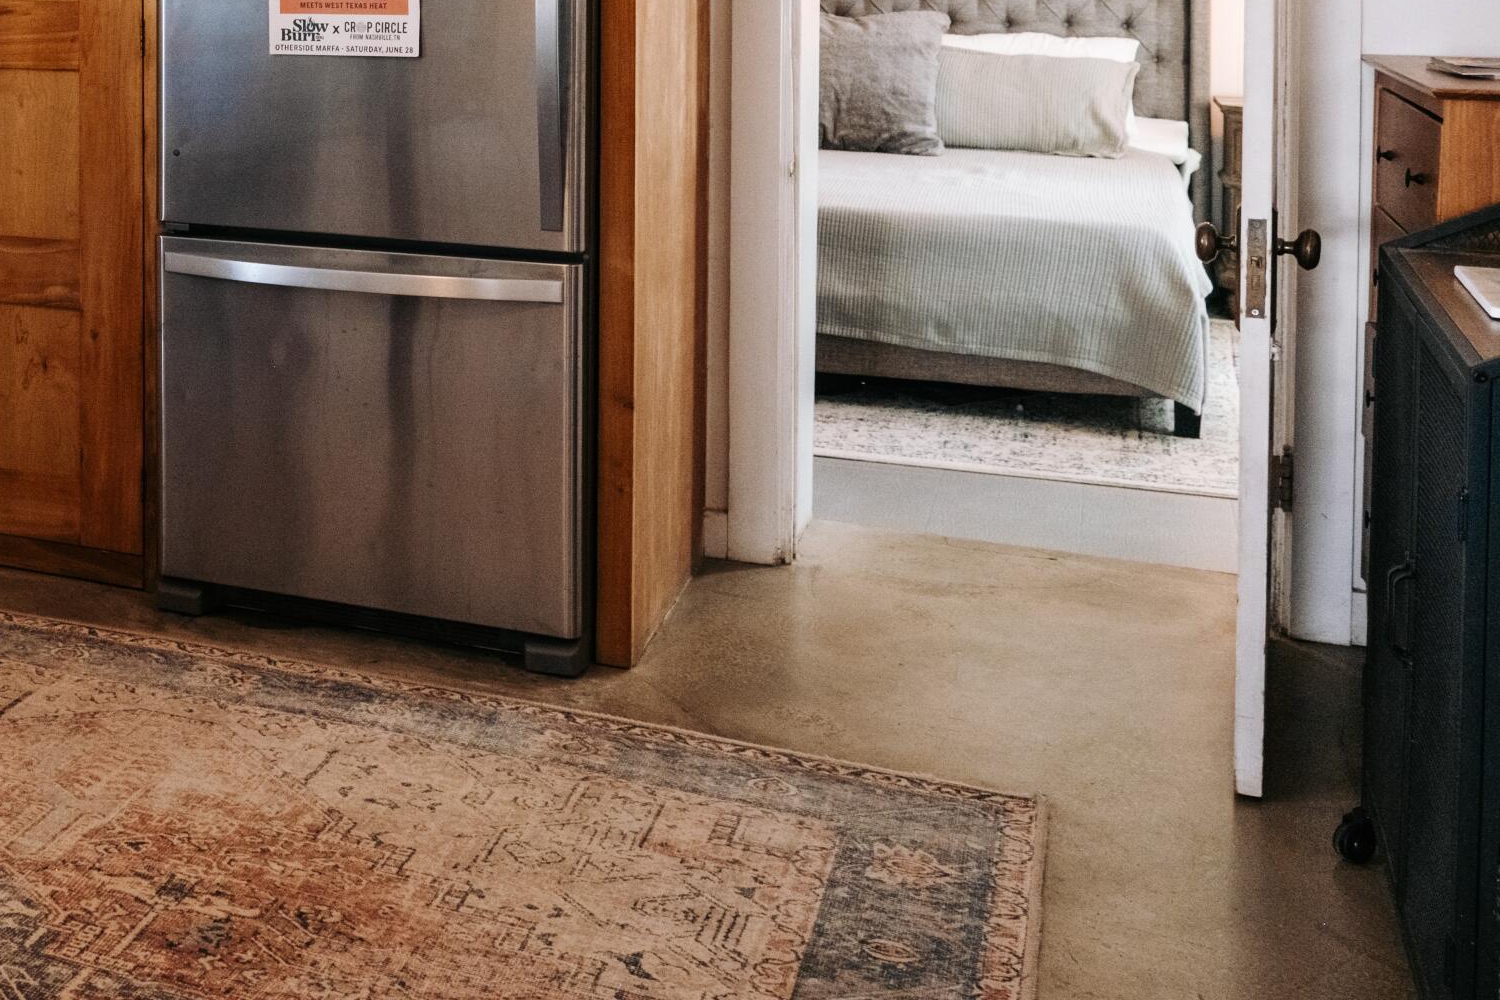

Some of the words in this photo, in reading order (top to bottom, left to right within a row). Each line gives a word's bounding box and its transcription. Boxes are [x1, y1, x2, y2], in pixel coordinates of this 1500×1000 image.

[300, 1, 323, 9] MEETS
[292, 18, 329, 33] Slow
[375, 22, 408, 34] CIRCLE
[275, 44, 315, 52] OTHERSIDE
[346, 45, 384, 54] SATURDAY,
[385, 46, 403, 54] JUNE
[405, 46, 414, 54] 28
